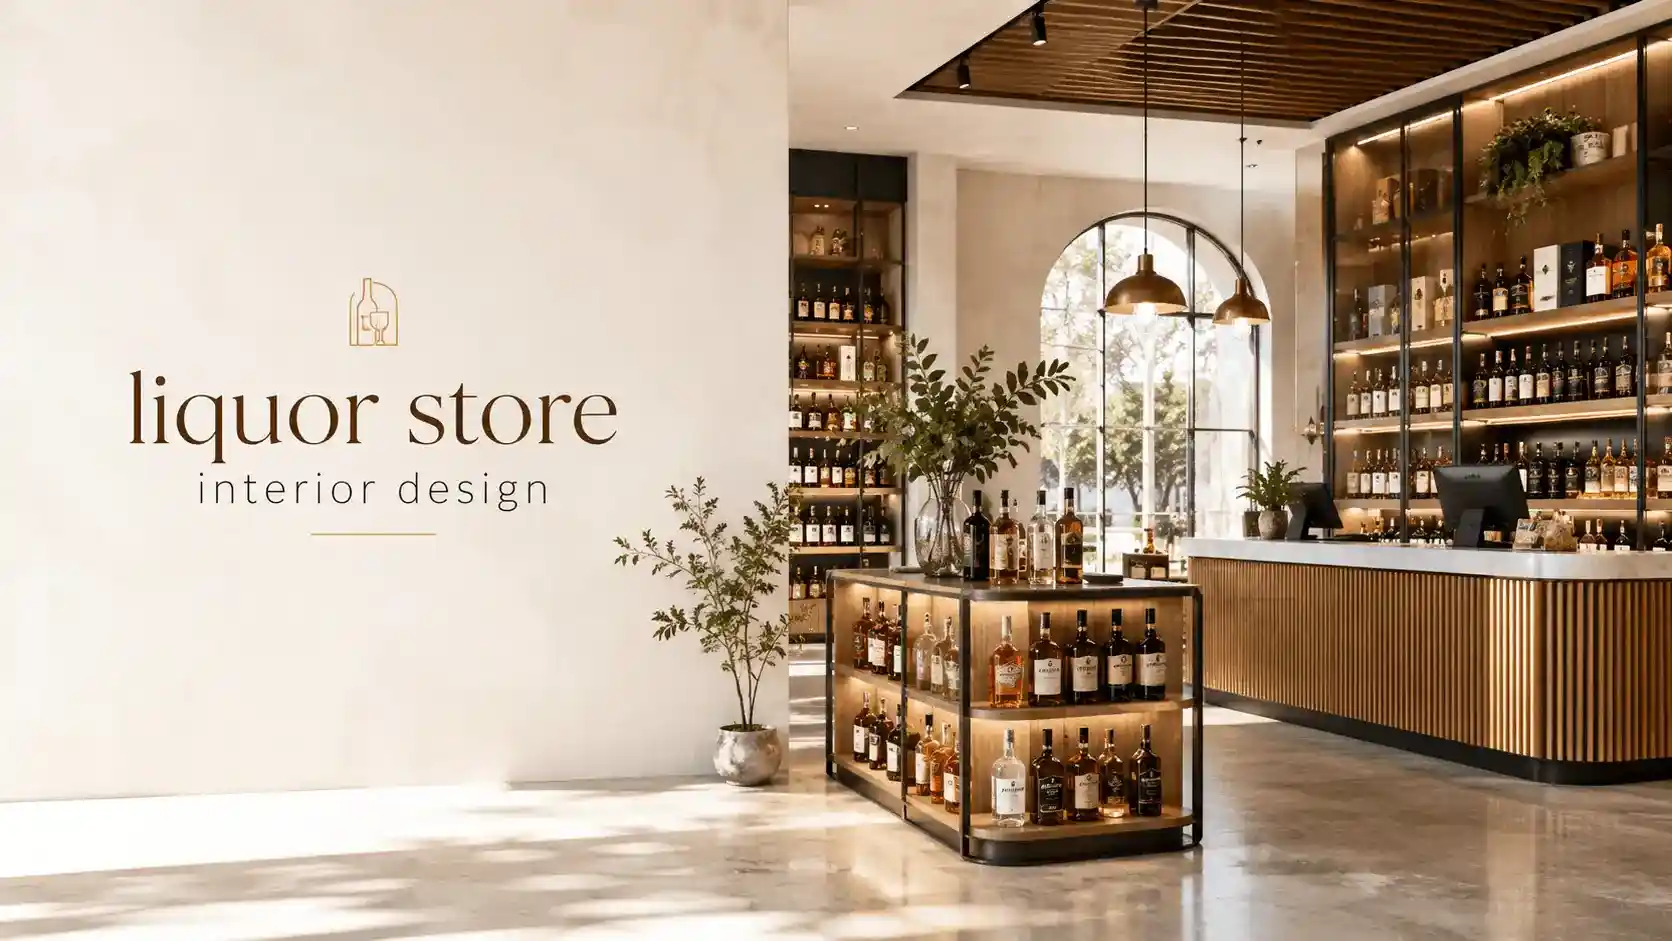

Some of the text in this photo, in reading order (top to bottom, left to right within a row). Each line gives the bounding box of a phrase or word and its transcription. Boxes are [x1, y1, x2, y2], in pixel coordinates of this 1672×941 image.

[129, 370, 618, 464] liquor store
[199, 471, 548, 512] interior design
